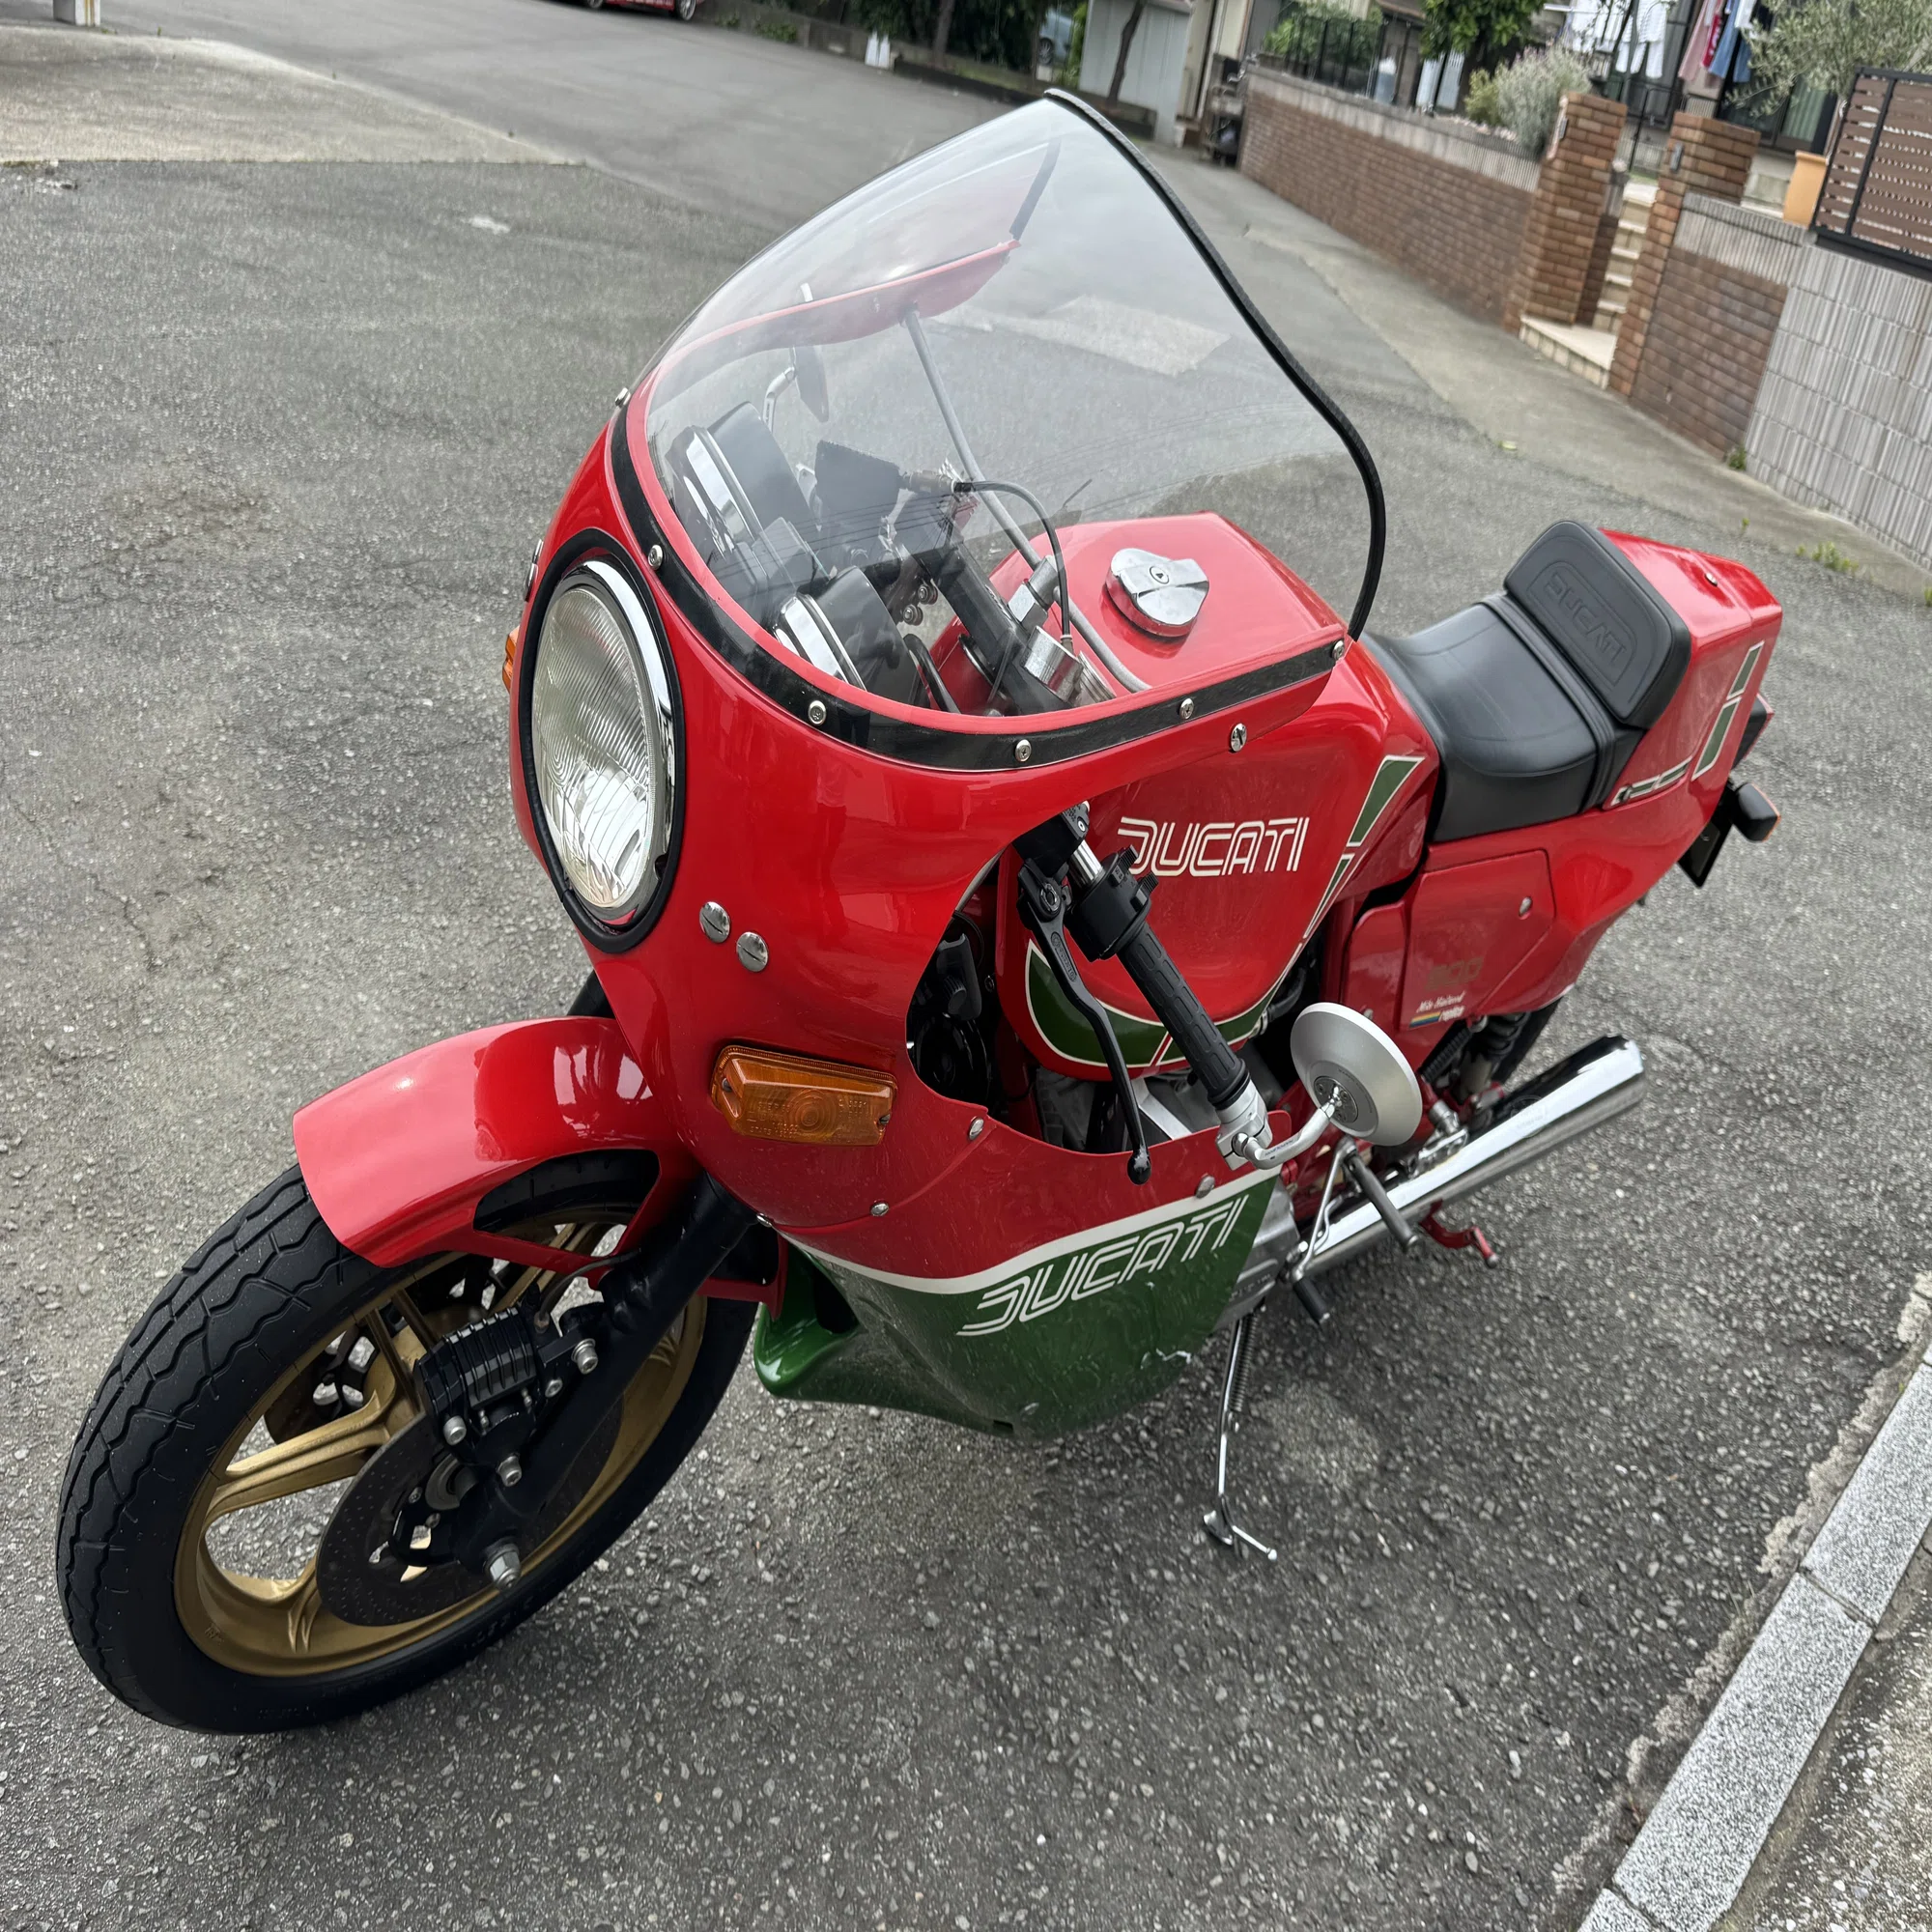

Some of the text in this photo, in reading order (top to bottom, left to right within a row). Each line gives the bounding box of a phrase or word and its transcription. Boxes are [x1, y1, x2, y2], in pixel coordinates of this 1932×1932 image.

[1545, 572, 1627, 664] DUCATI
[1118, 816, 1310, 877] DUCATI
[955, 1194, 1250, 1337] DUCATI
